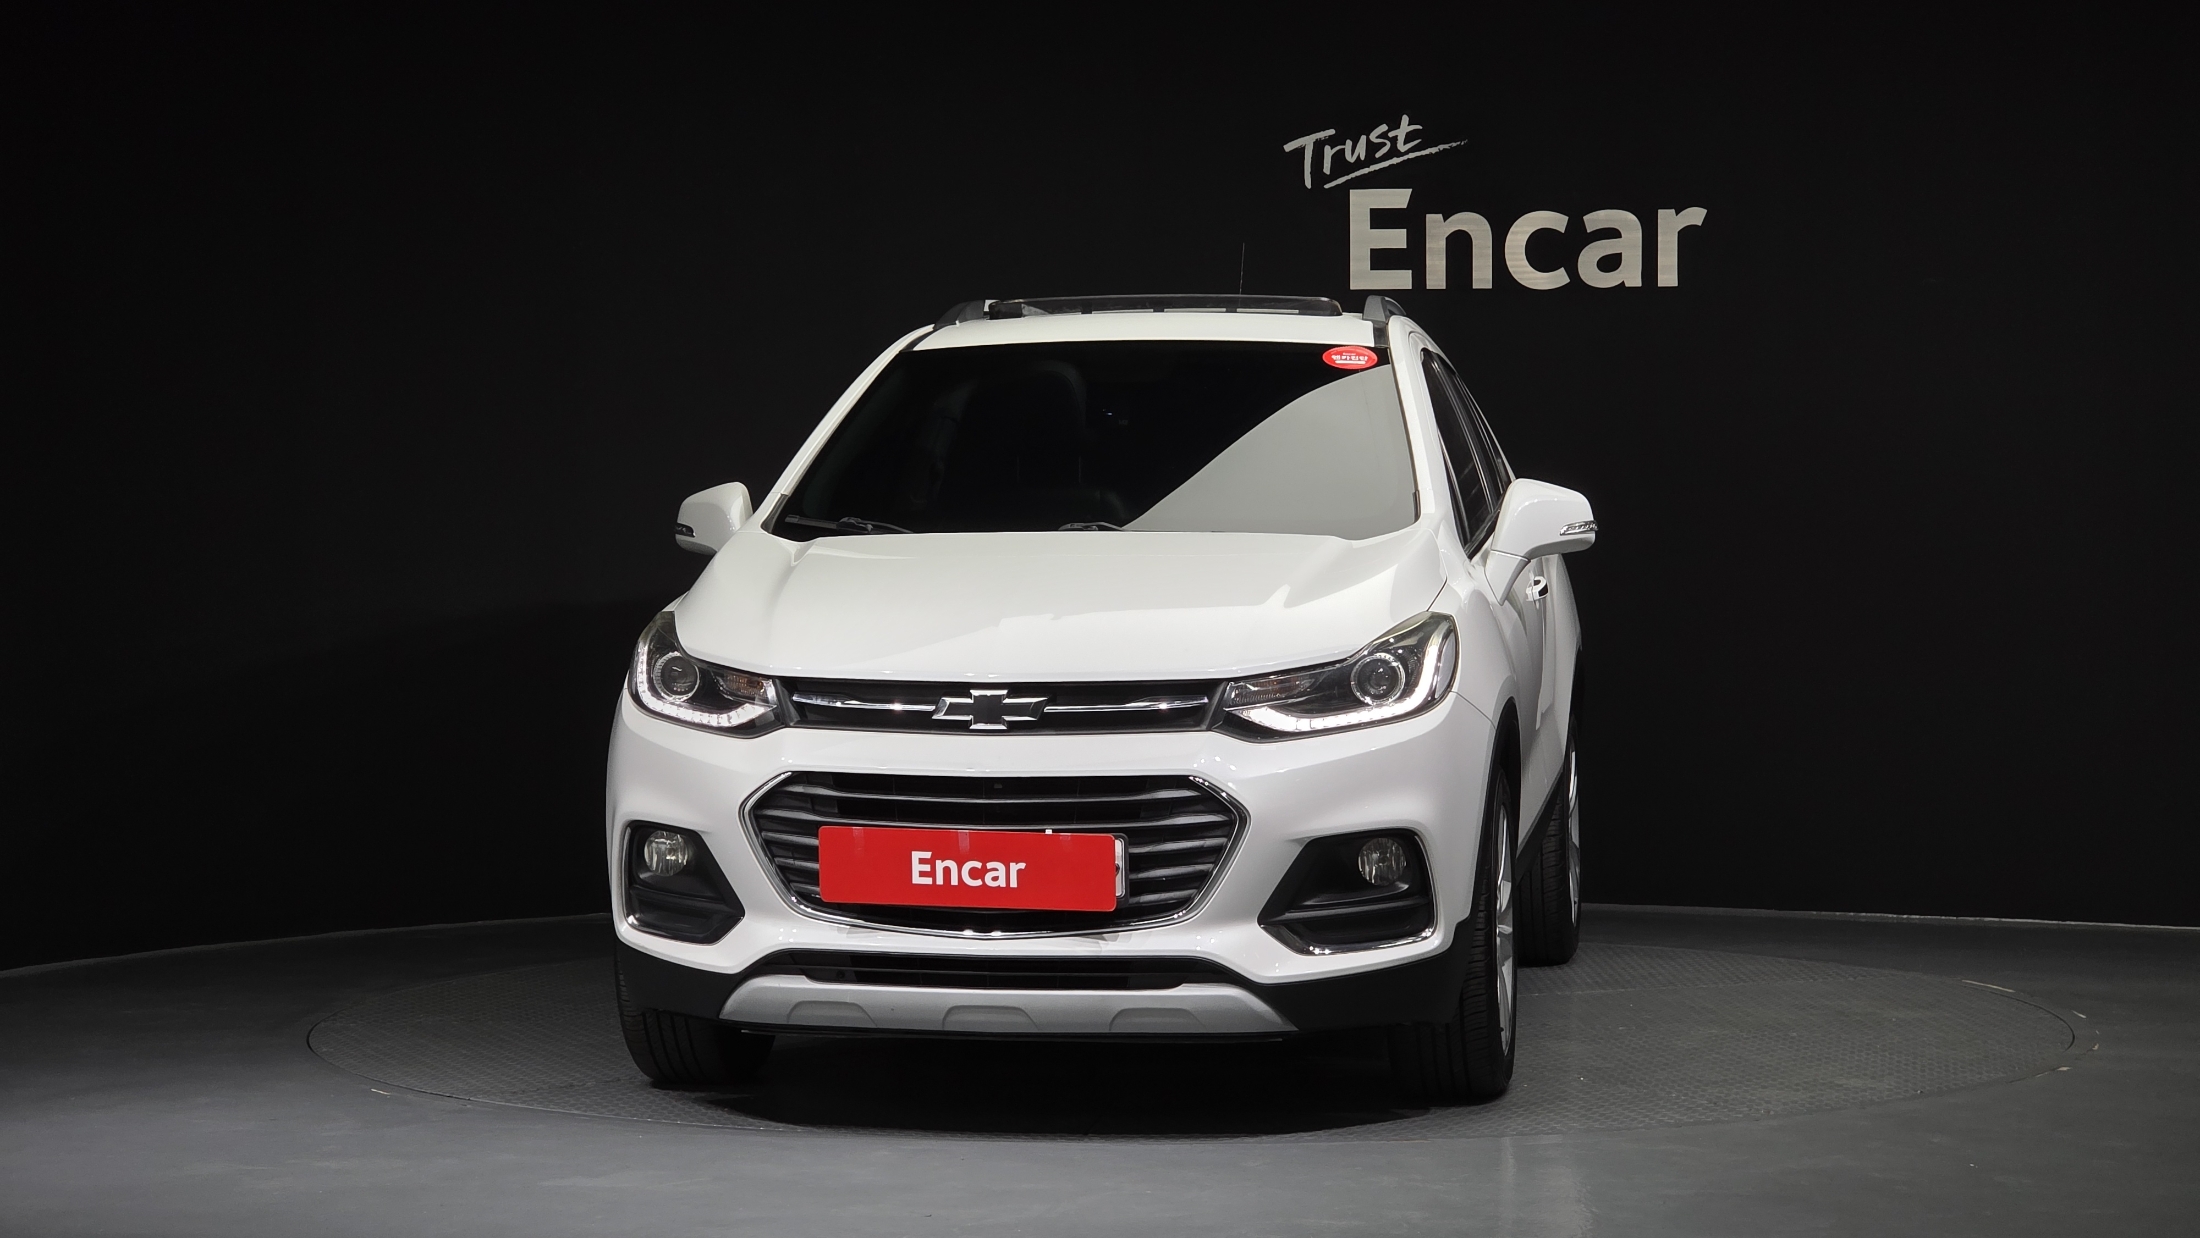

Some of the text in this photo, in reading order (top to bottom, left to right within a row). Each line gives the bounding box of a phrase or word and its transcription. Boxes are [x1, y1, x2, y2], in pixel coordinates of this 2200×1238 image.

[1283, 114, 1423, 189] Trust
[1349, 188, 1708, 290] Encar
[910, 850, 1027, 888] Encar
